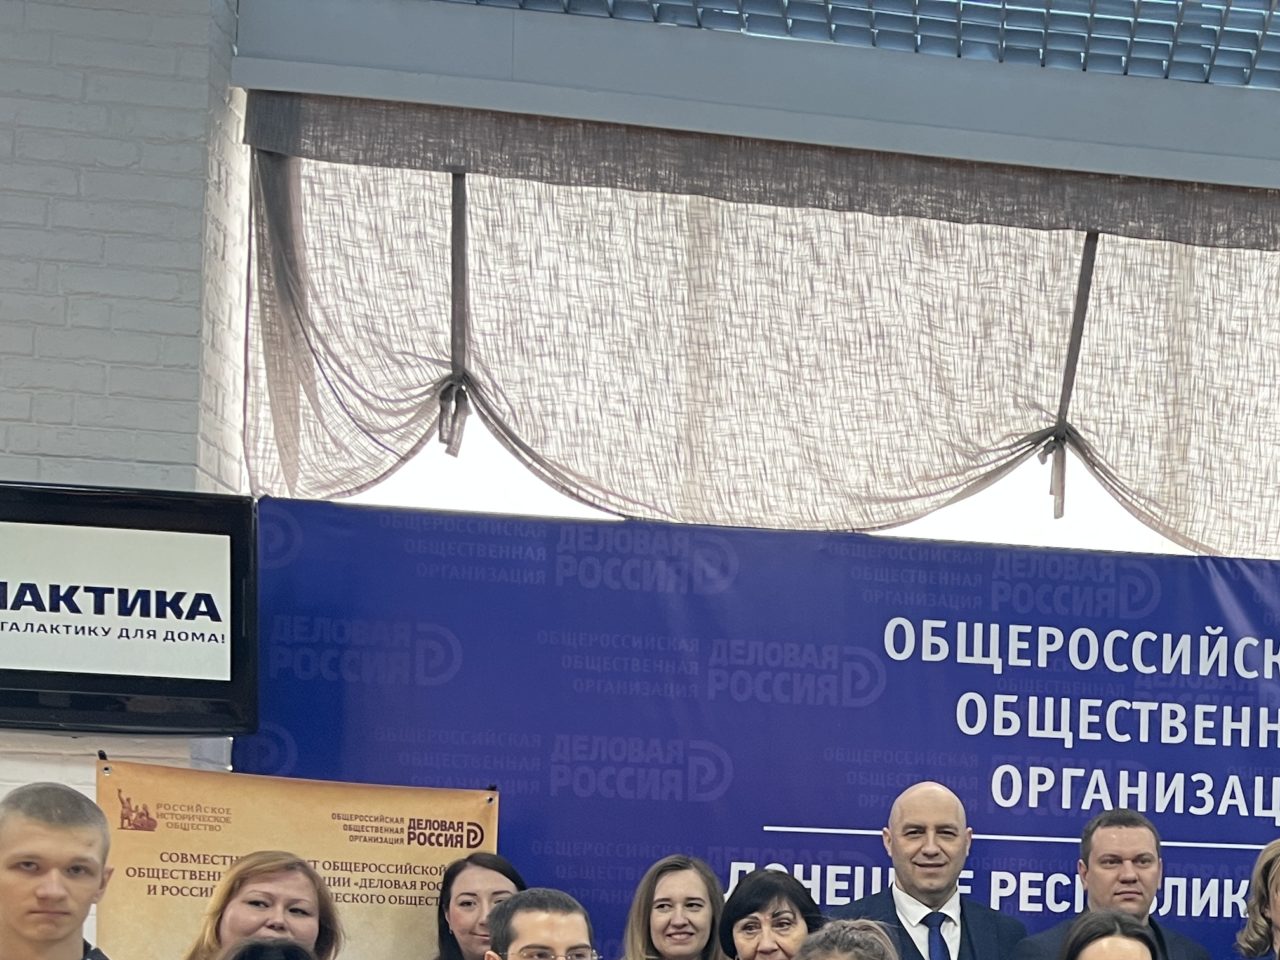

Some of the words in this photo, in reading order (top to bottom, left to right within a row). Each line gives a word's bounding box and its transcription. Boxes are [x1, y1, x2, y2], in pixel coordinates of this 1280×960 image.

[0, 582, 223, 623] АКТИКА
[991, 581, 1116, 617] РОССИЯ
[117, 627, 157, 640] ДЛЯ
[162, 630, 226, 644] ДОМА!
[708, 639, 839, 670] ДЕЛОВАЯ
[707, 669, 838, 706] РОССИЯ
[550, 734, 685, 765] ДЕЛОВАЯ
[550, 764, 683, 800] РОССИЯ
[156, 803, 232, 815] РОССИЙСКОЕ
[156, 812, 231, 823] ИСТОРИЧЕСКОЕ
[331, 812, 405, 824] ОБЩЕРОССИЙСКАЯ
[166, 820, 222, 832] ОБЩЕСТВО
[343, 823, 405, 835] ОБЩЕСТВЕННАЯ
[408, 818, 464, 833] ДЕЛОВАЯ
[349, 834, 404, 845] ОРГАНИЗАЦИЯ
[407, 831, 464, 848] РОССИЯ
[147, 884, 157, 896] И
[354, 879, 416, 891] «ДЕЛОВАЯ
